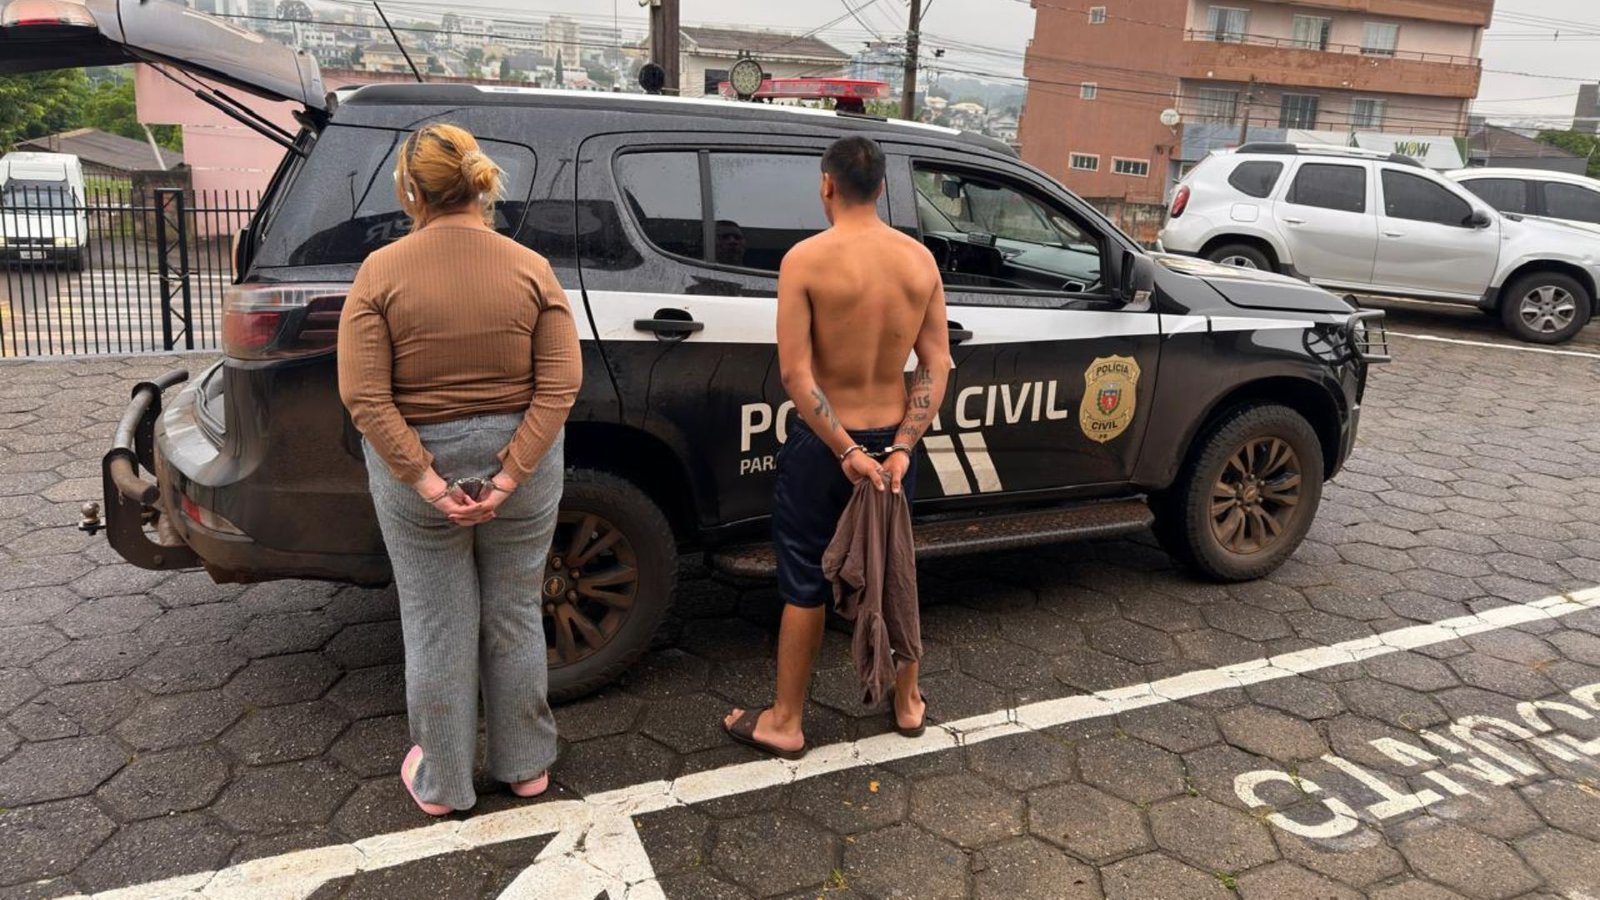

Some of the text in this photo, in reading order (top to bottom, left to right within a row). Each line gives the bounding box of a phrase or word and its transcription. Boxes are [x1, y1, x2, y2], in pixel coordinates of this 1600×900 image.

[1395, 142, 1430, 157] WOW
[956, 380, 1068, 429] CIVIL
[1091, 421, 1118, 431] CIVIL
[740, 455, 777, 476] PAR
